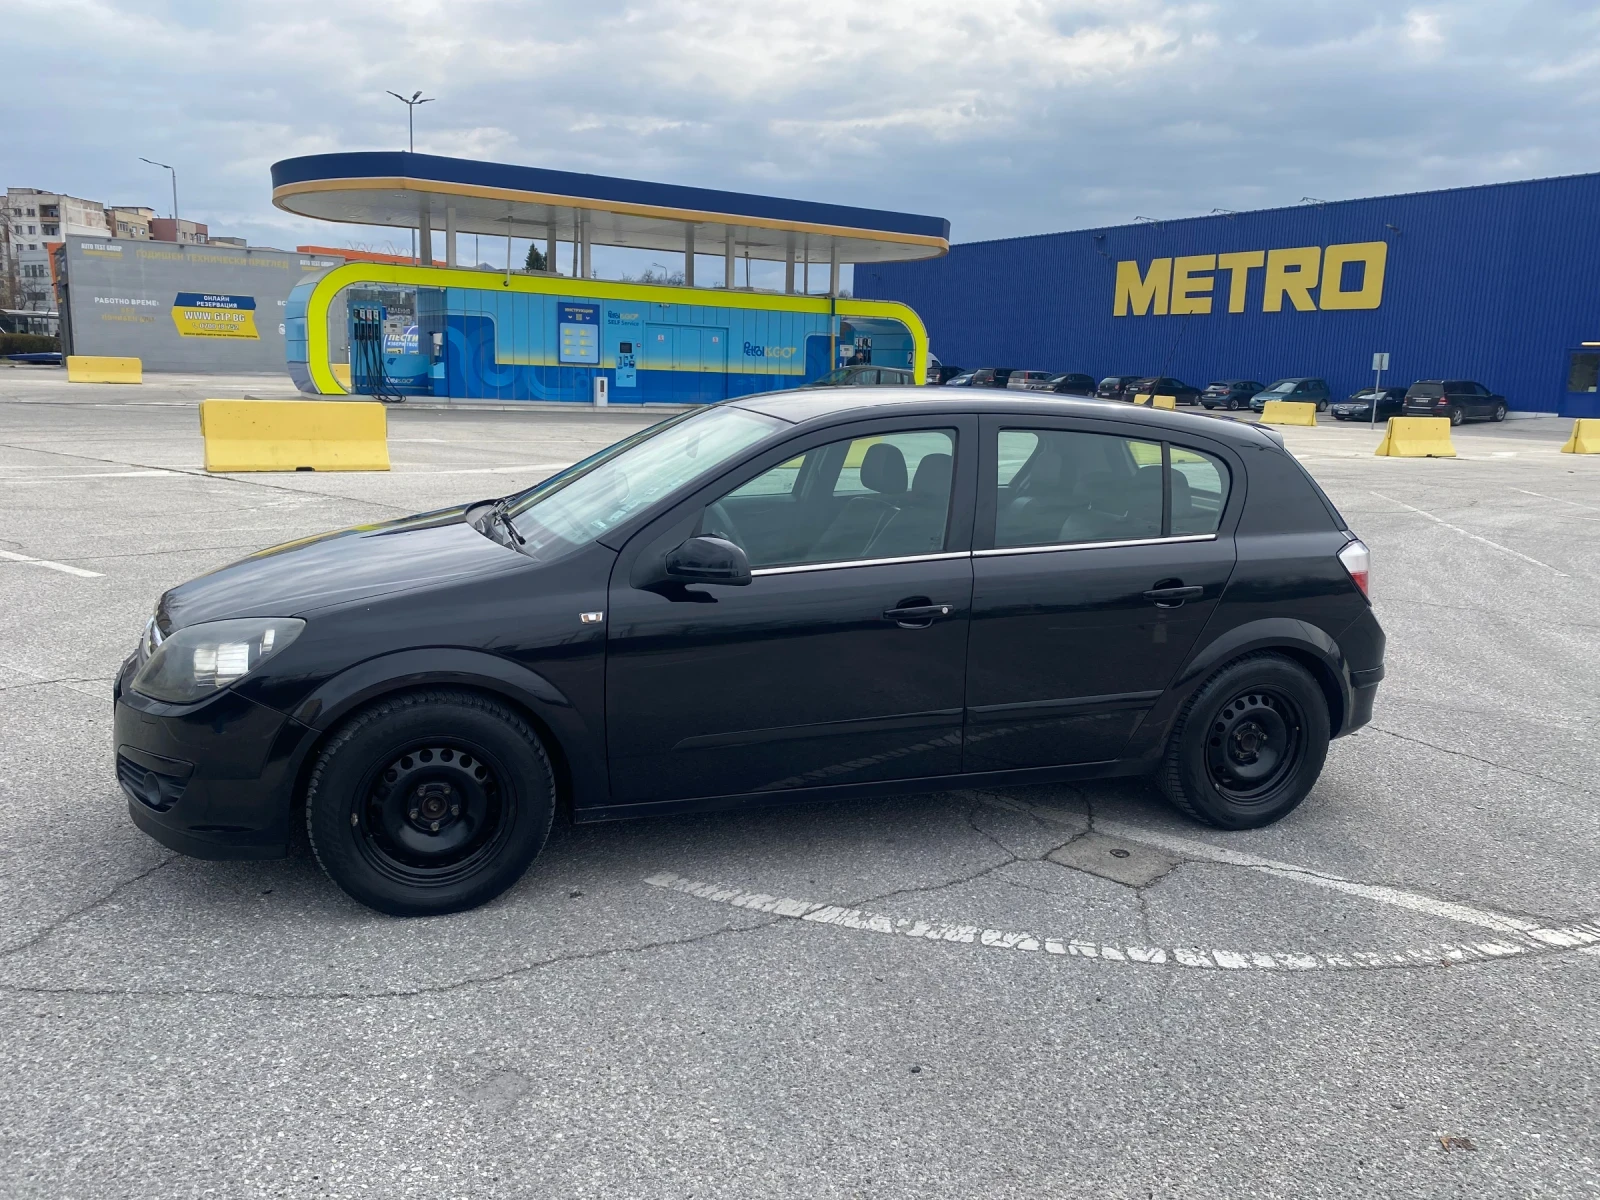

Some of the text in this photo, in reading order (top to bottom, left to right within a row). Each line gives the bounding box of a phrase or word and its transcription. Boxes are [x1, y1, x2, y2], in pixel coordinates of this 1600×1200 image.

[186, 253, 247, 266] ТЕХНИЧЕСКИ
[1113, 241, 1388, 316] METRO
[95, 297, 160, 307] РАБОТНО ВРЕМЕ:
[196, 301, 238, 309] РЕЗЕРВАЦИЯ
[184, 311, 245, 322] WWW.GTP.BG
[907, 352, 913, 365] 2
